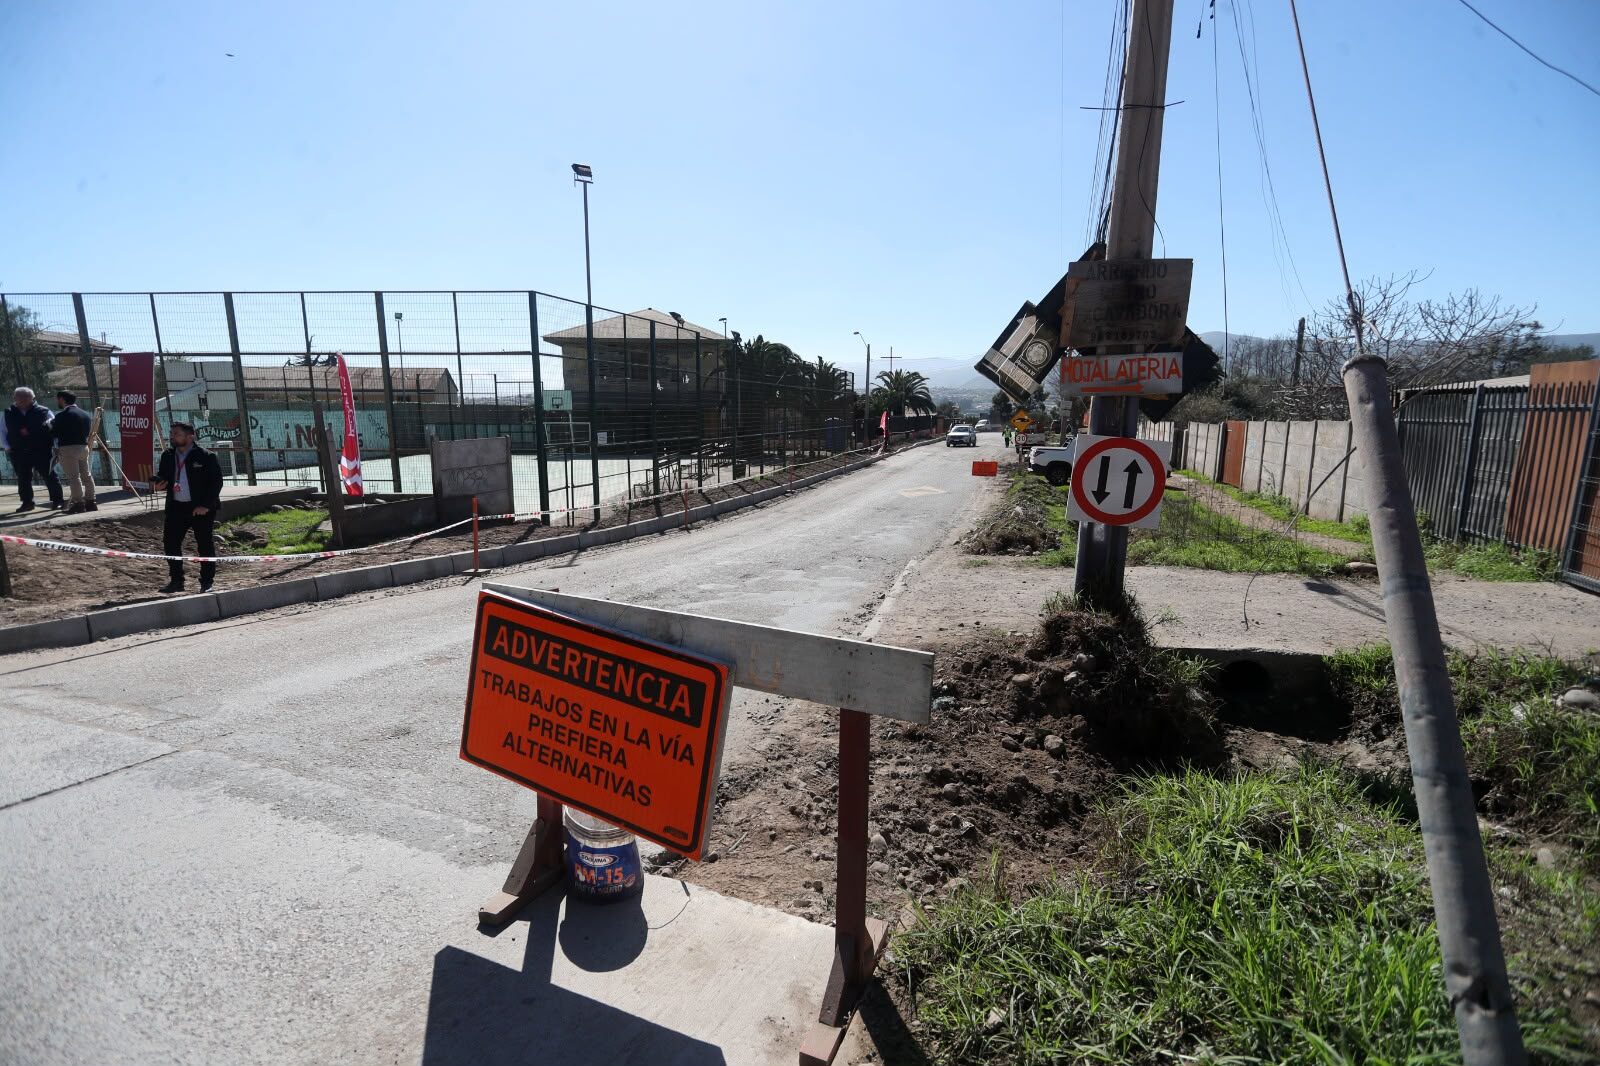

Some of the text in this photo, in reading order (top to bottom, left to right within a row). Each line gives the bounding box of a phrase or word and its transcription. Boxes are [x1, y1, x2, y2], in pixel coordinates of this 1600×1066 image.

[121, 393, 147, 405] #OBRAS
[121, 406, 136, 417] CON
[121, 417, 149, 429] FUTURO
[493, 625, 692, 718] ADVERTENCIA
[481, 670, 695, 767] TRABAJOS EN LA VÍA
[528, 714, 627, 769] PREFIERA
[502, 732, 652, 807] ALTERNATIVAS
